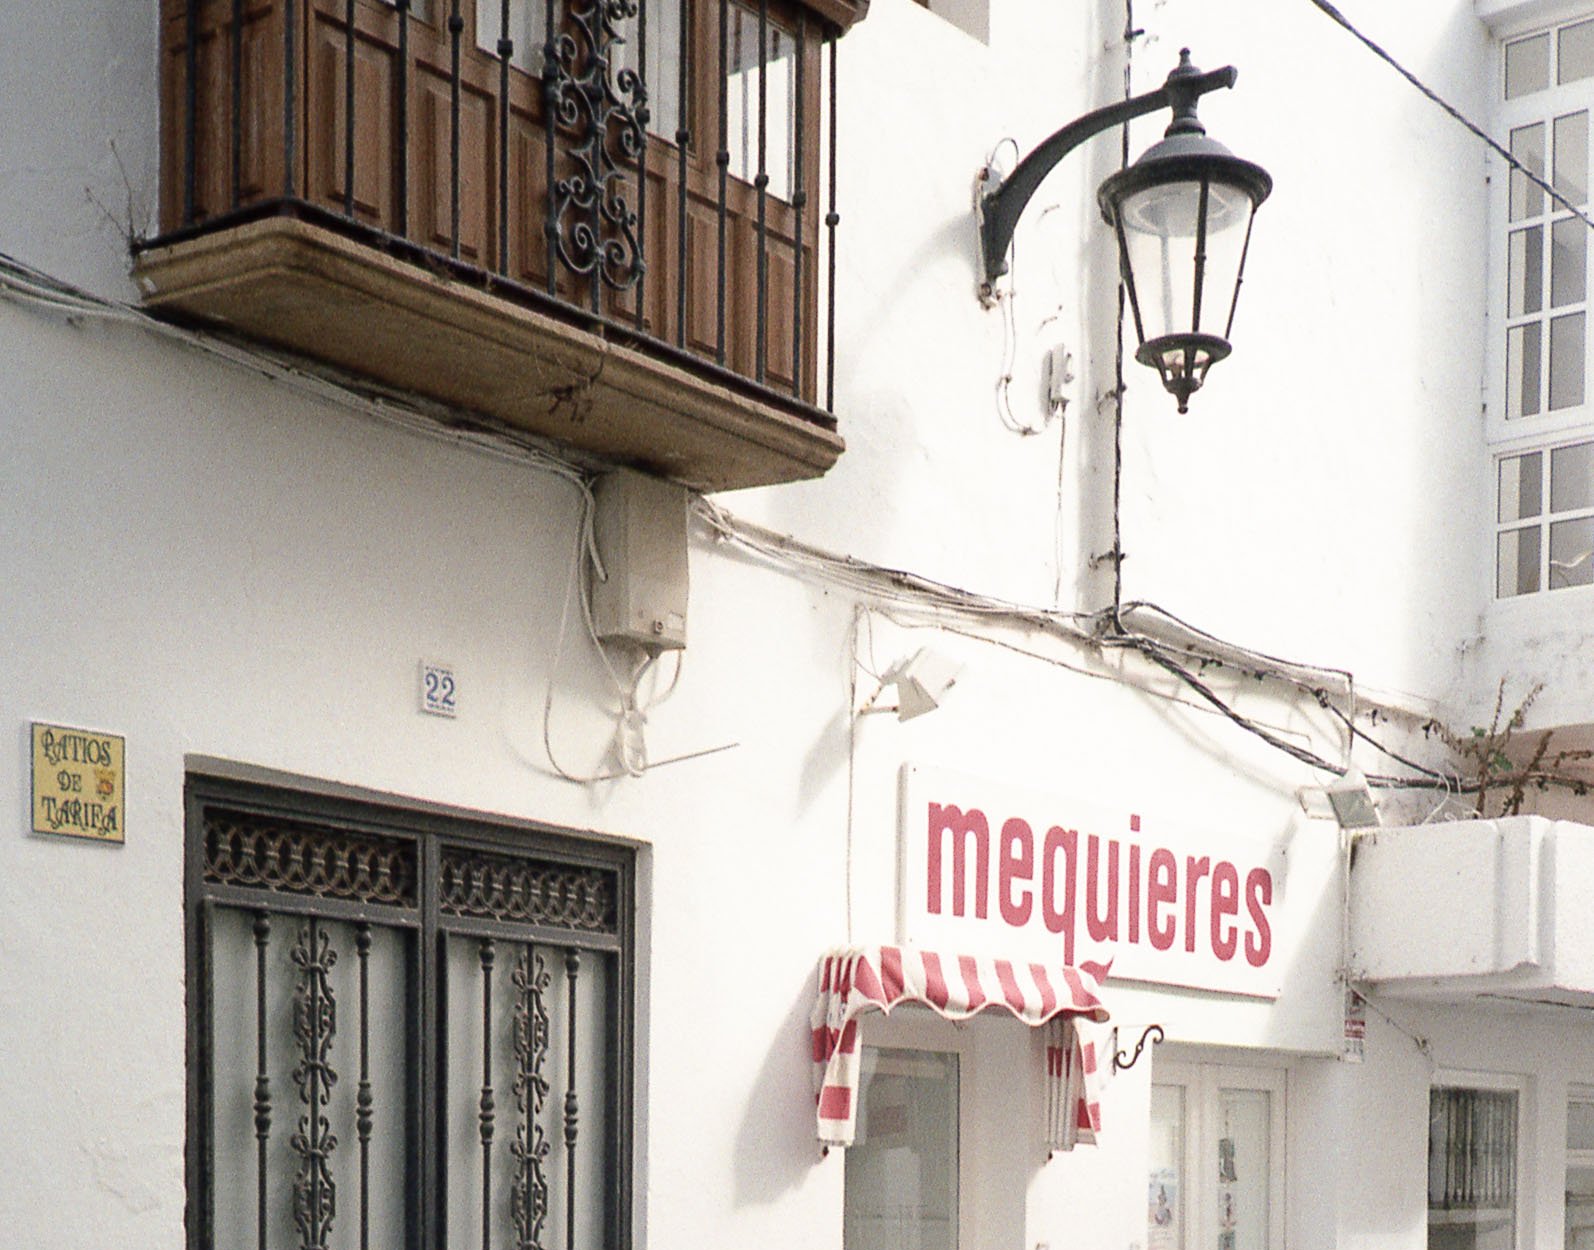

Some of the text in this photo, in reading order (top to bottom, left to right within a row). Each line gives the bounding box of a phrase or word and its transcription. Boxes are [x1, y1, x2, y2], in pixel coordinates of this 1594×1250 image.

[425, 672, 456, 706] 22
[41, 728, 112, 767] PATIOS
[57, 769, 82, 792] DE
[41, 796, 118, 836] TARIFA
[927, 801, 1273, 968] mequieres
